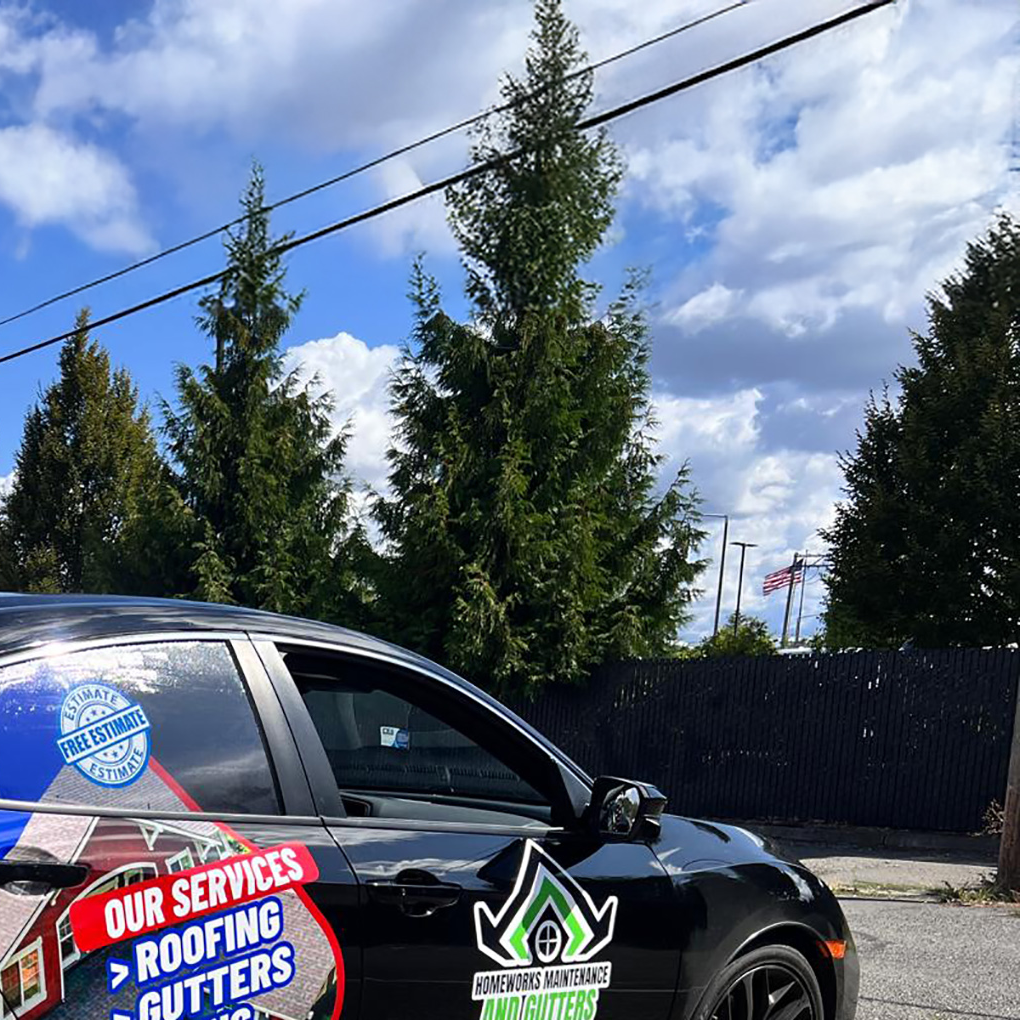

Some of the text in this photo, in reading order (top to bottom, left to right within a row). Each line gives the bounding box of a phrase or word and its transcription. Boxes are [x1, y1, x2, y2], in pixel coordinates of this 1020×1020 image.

[65, 689, 118, 721] ESTIMATE
[60, 709, 146, 758] FREE ESTIMATE
[90, 747, 143, 780] ESTIMATE
[104, 848, 304, 939] OUR SERVICES
[134, 900, 281, 982] ROOFING
[475, 966, 609, 996] HOMEWORKS MAINTENANCE
